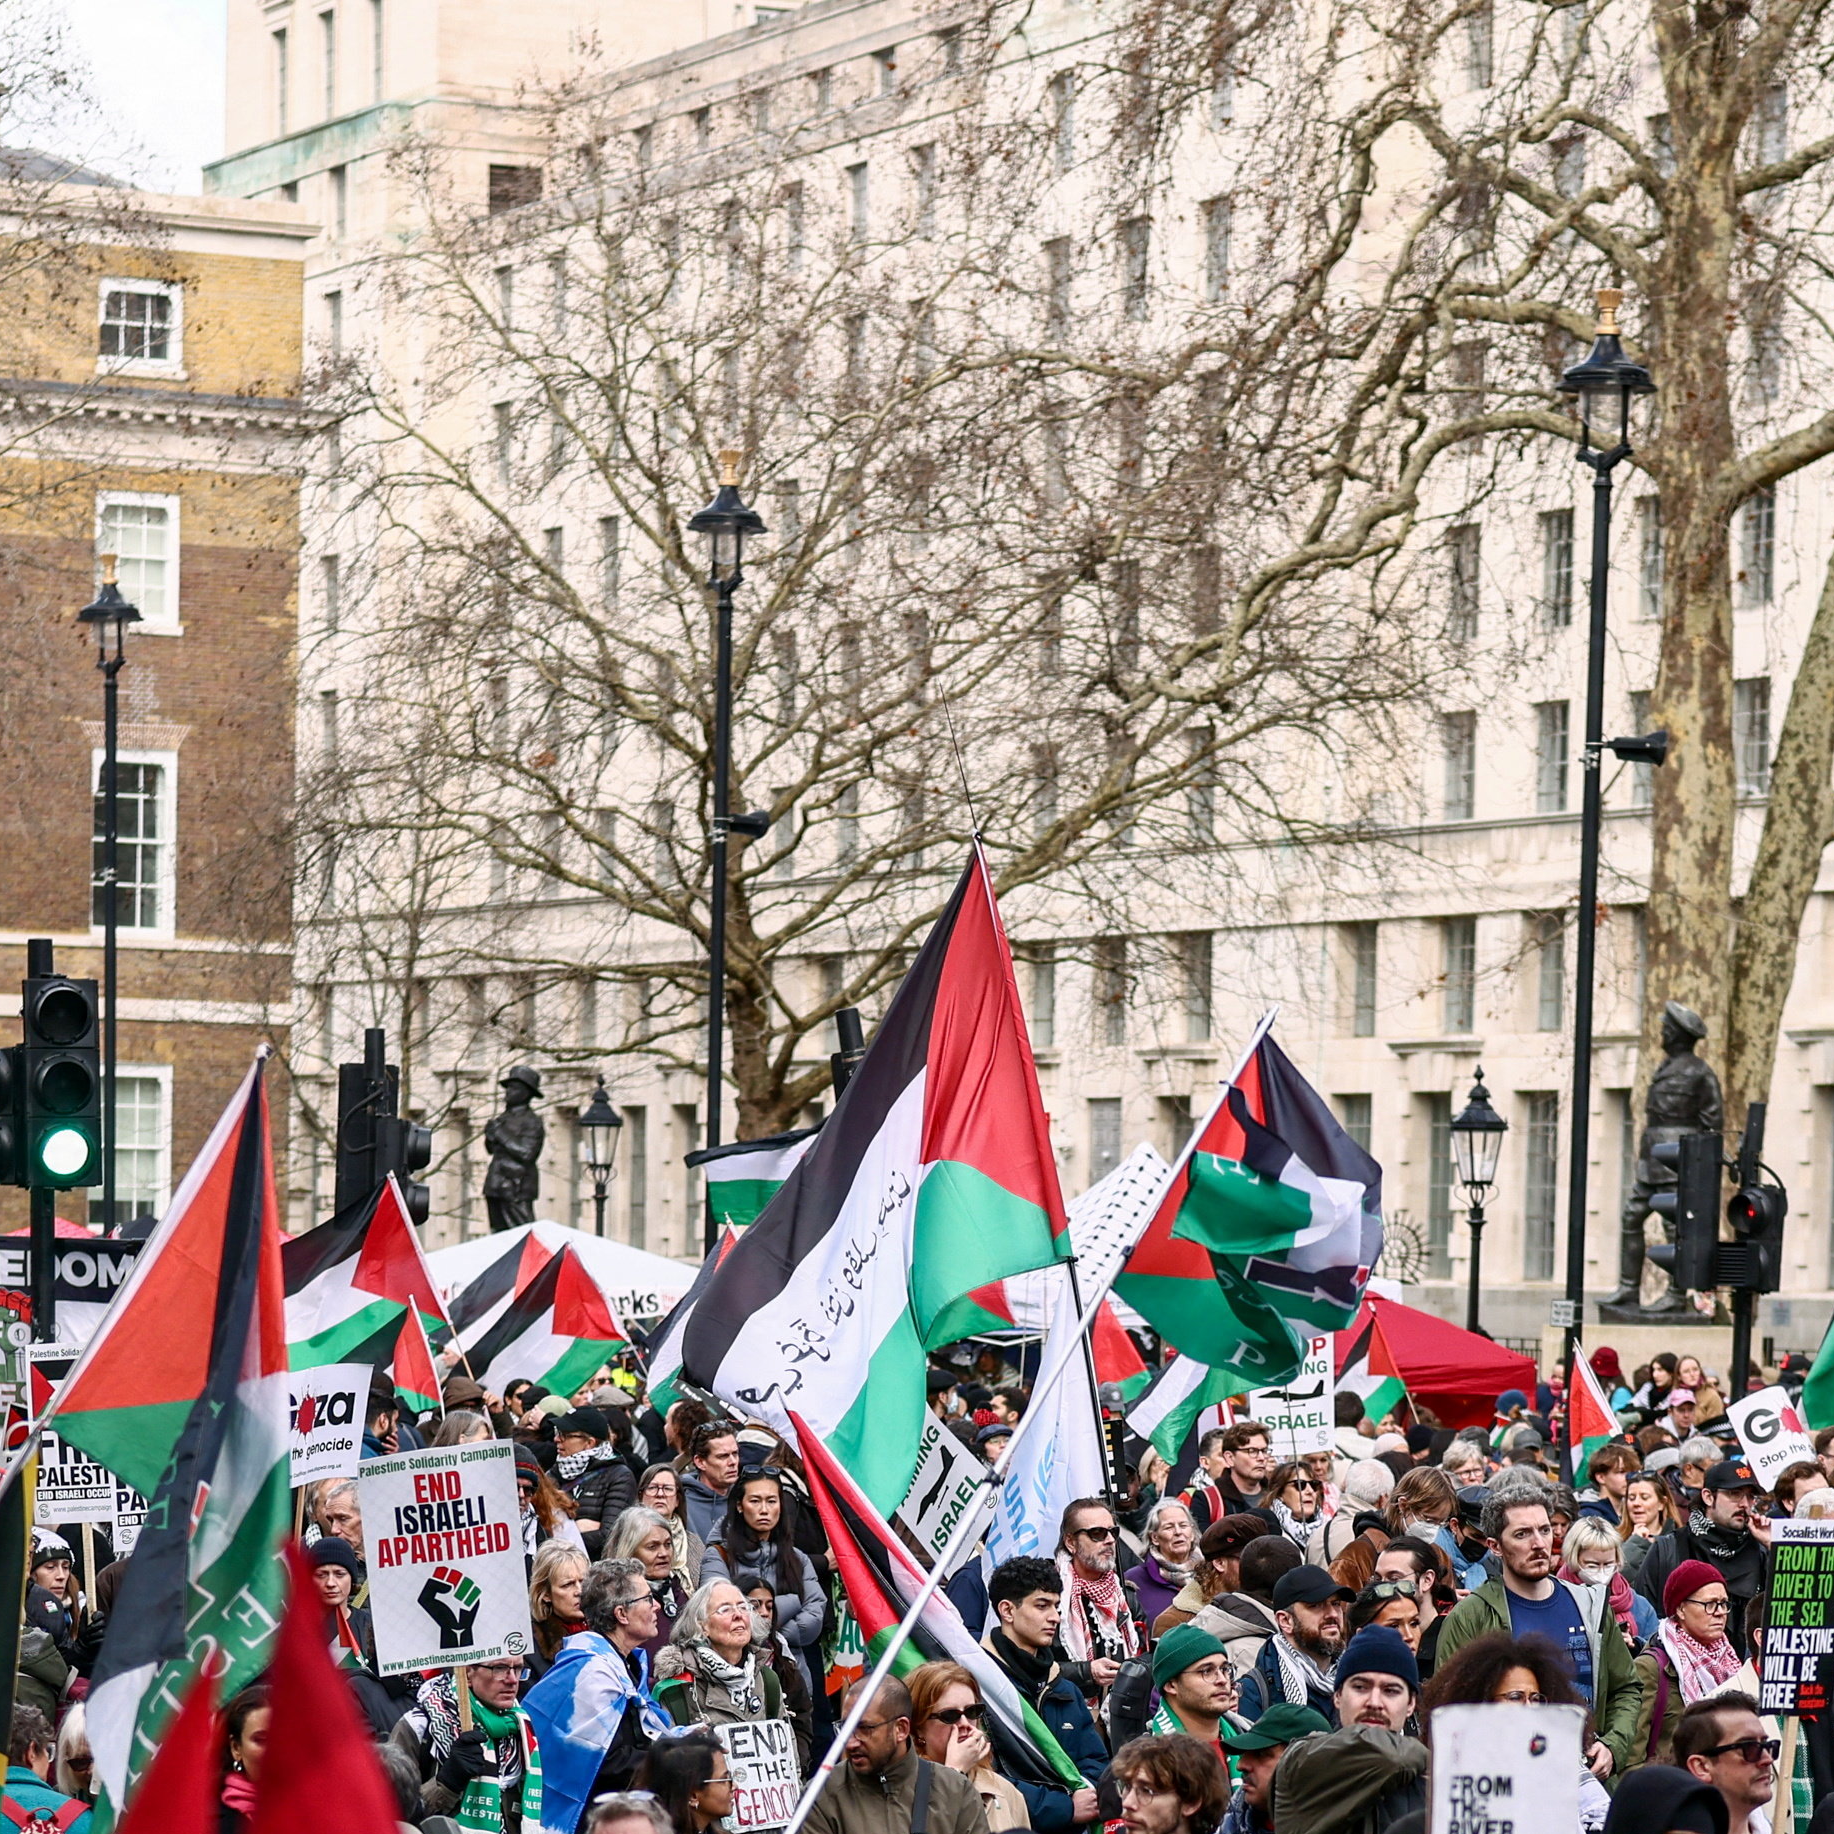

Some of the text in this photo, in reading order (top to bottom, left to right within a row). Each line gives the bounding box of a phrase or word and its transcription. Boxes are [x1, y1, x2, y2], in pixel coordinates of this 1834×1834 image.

[29, 1349, 59, 1359] Palestine
[292, 1438, 353, 1460] the genocide
[359, 1445, 512, 1478] Palestine Solidarity Campaign
[1759, 1443, 1807, 1468] Stop the
[37, 1492, 54, 1500] END
[55, 1490, 85, 1500] ISRAELI
[413, 1470, 461, 1504] END
[119, 1514, 137, 1526] END
[394, 1495, 487, 1536] ISRAELI
[930, 1474, 983, 1554] ISRAEL
[378, 1522, 511, 1568] APARTHEID
[1782, 1526, 1818, 1540] Socialist
[1775, 1546, 1817, 1572] FROM
[1772, 1573, 1833, 1600] RIVER TO
[1770, 1601, 1825, 1627] THE SEA
[1765, 1628, 1834, 1654] PALESTINE
[383, 1646, 502, 1673] www.palestinecampaign.org
[1764, 1656, 1819, 1682] WILL BE
[1761, 1683, 1797, 1710] FREE
[729, 1722, 789, 1760] END
[747, 1758, 793, 1782] THE
[1450, 1776, 1512, 1798] FROM
[467, 1795, 493, 1806] FREE
